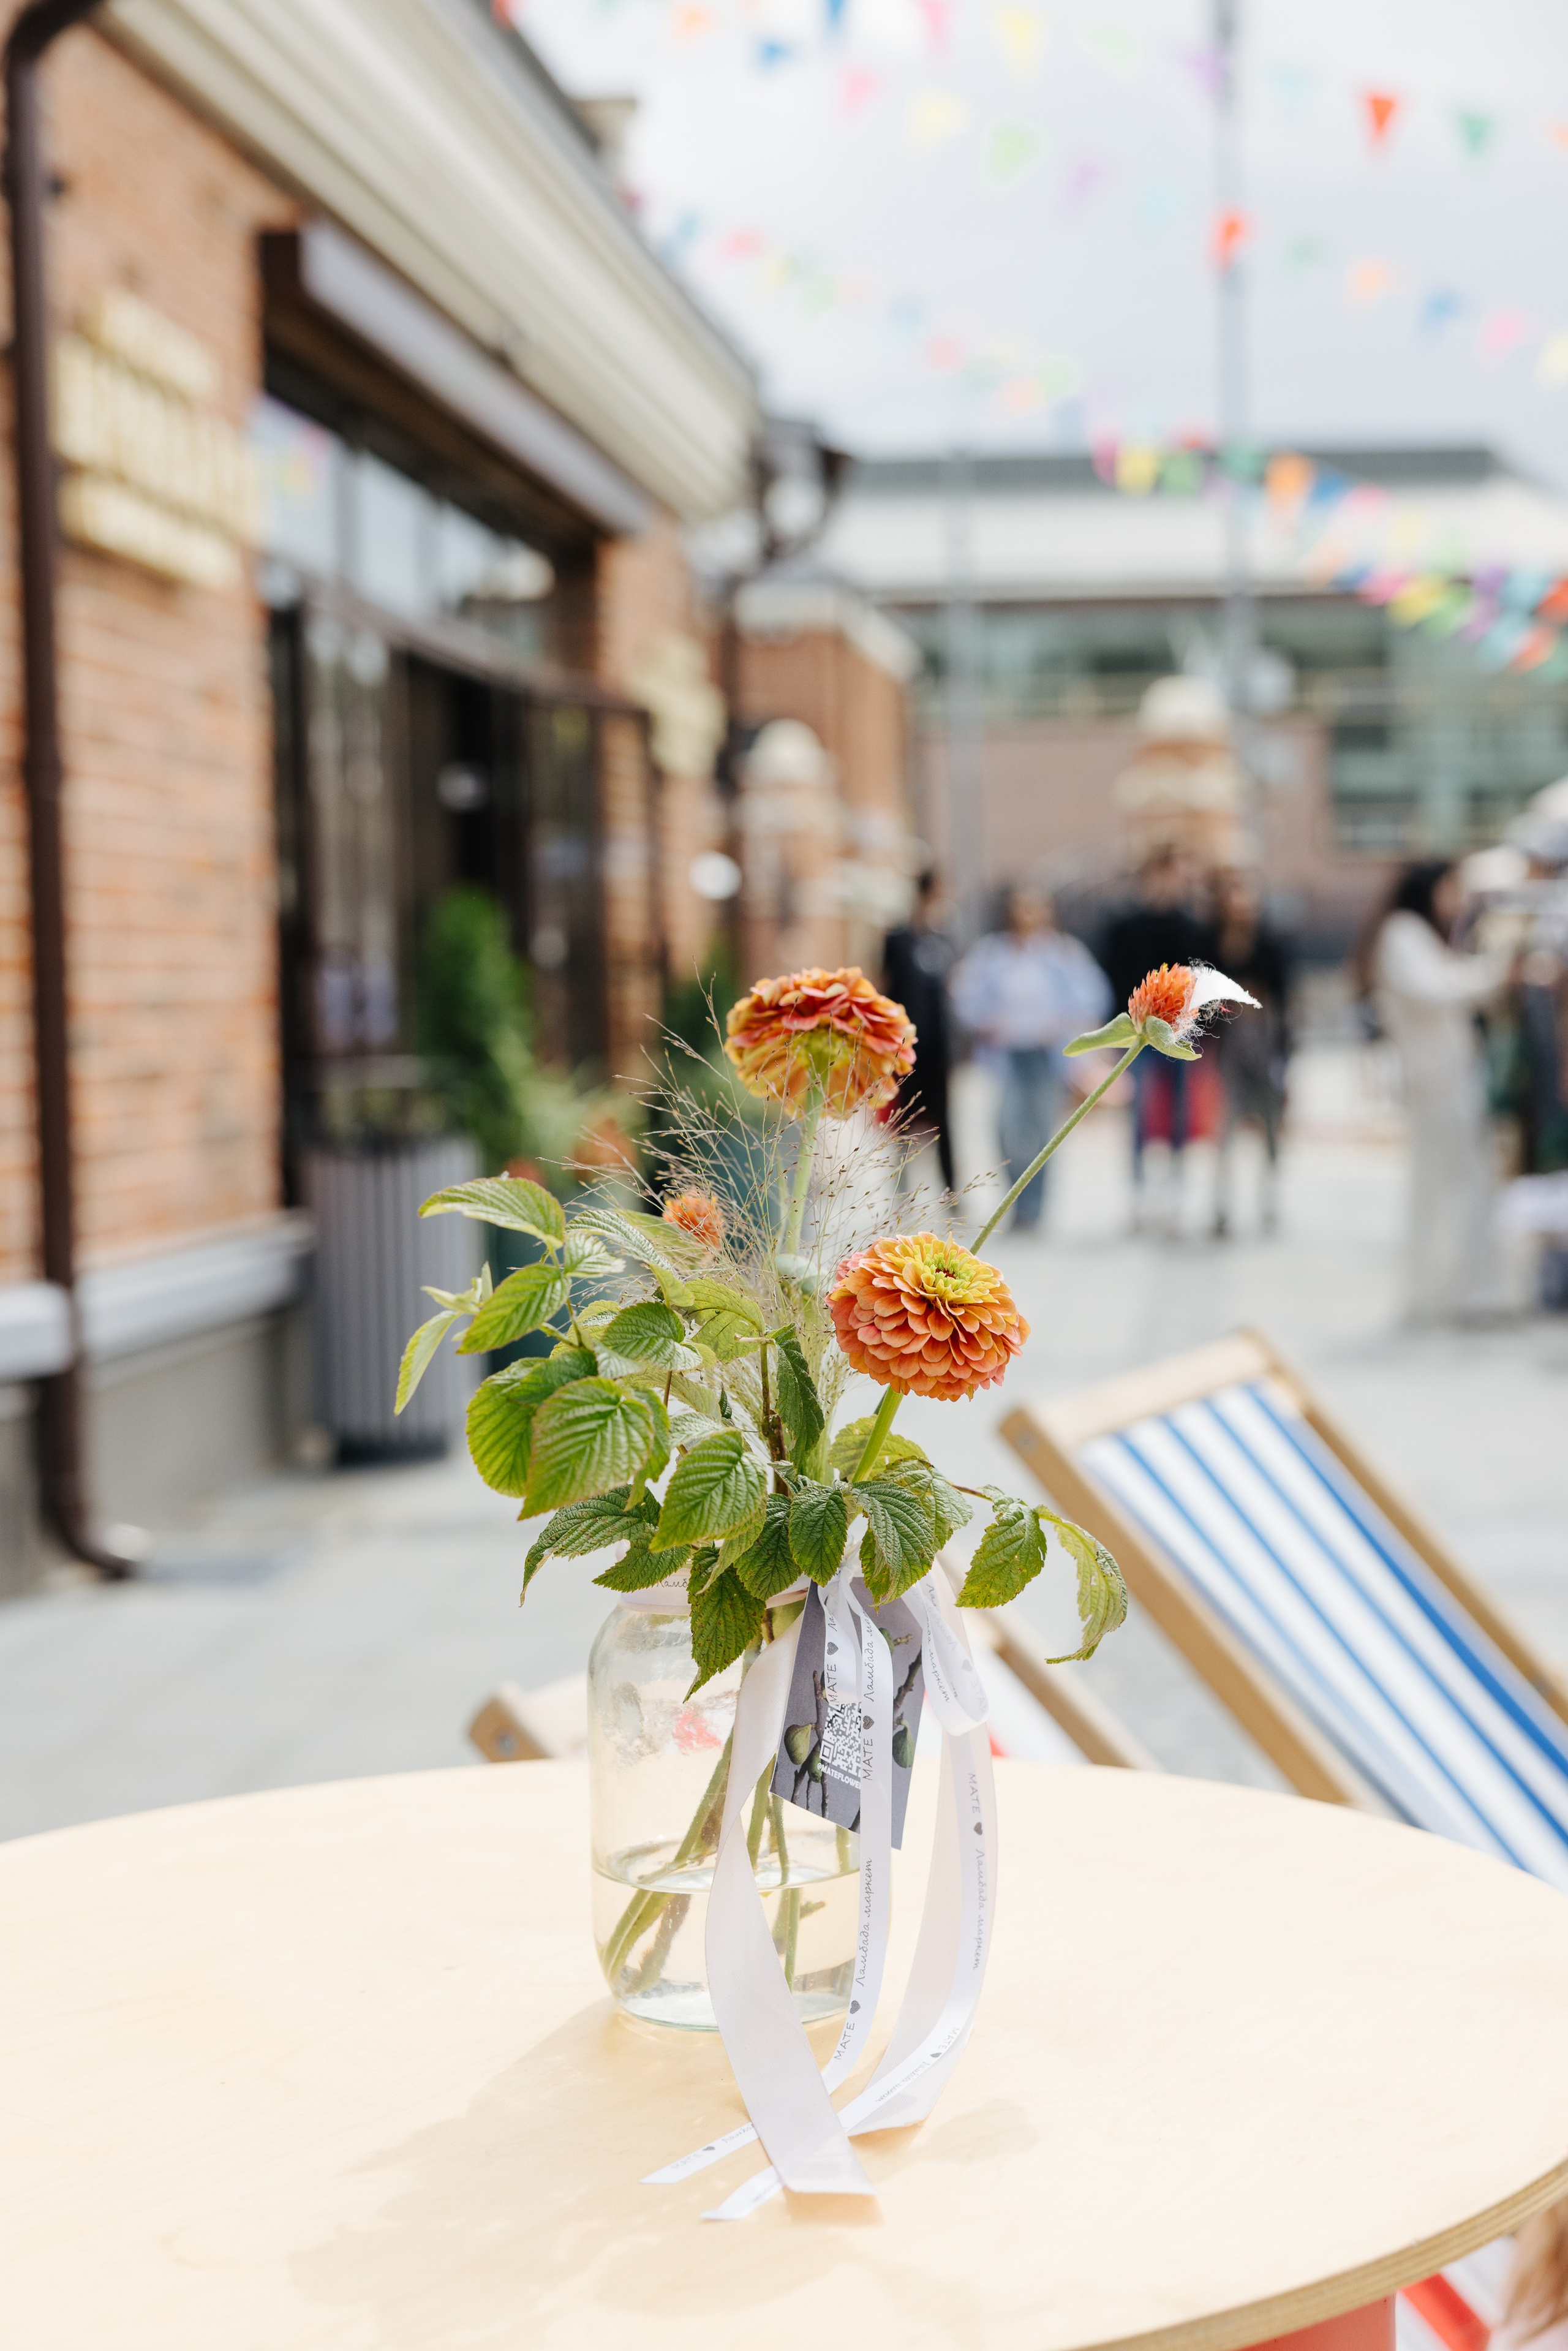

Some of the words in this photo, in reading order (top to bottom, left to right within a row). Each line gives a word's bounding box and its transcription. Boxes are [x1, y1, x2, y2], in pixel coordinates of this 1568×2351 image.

[826, 1664, 839, 1704] MATE
[864, 1641, 875, 1702] Ламбада
[929, 1648, 950, 1703] маркет
[816, 1762, 861, 1790] @MATEFLOWE
[862, 1738, 873, 1781] MATE
[967, 1772, 981, 1814] MATE
[976, 1847, 987, 1909] Ламбада
[856, 1922, 870, 1988] Ламбада
[864, 1857, 874, 1918] маркет
[834, 2022, 854, 2060] MATE
